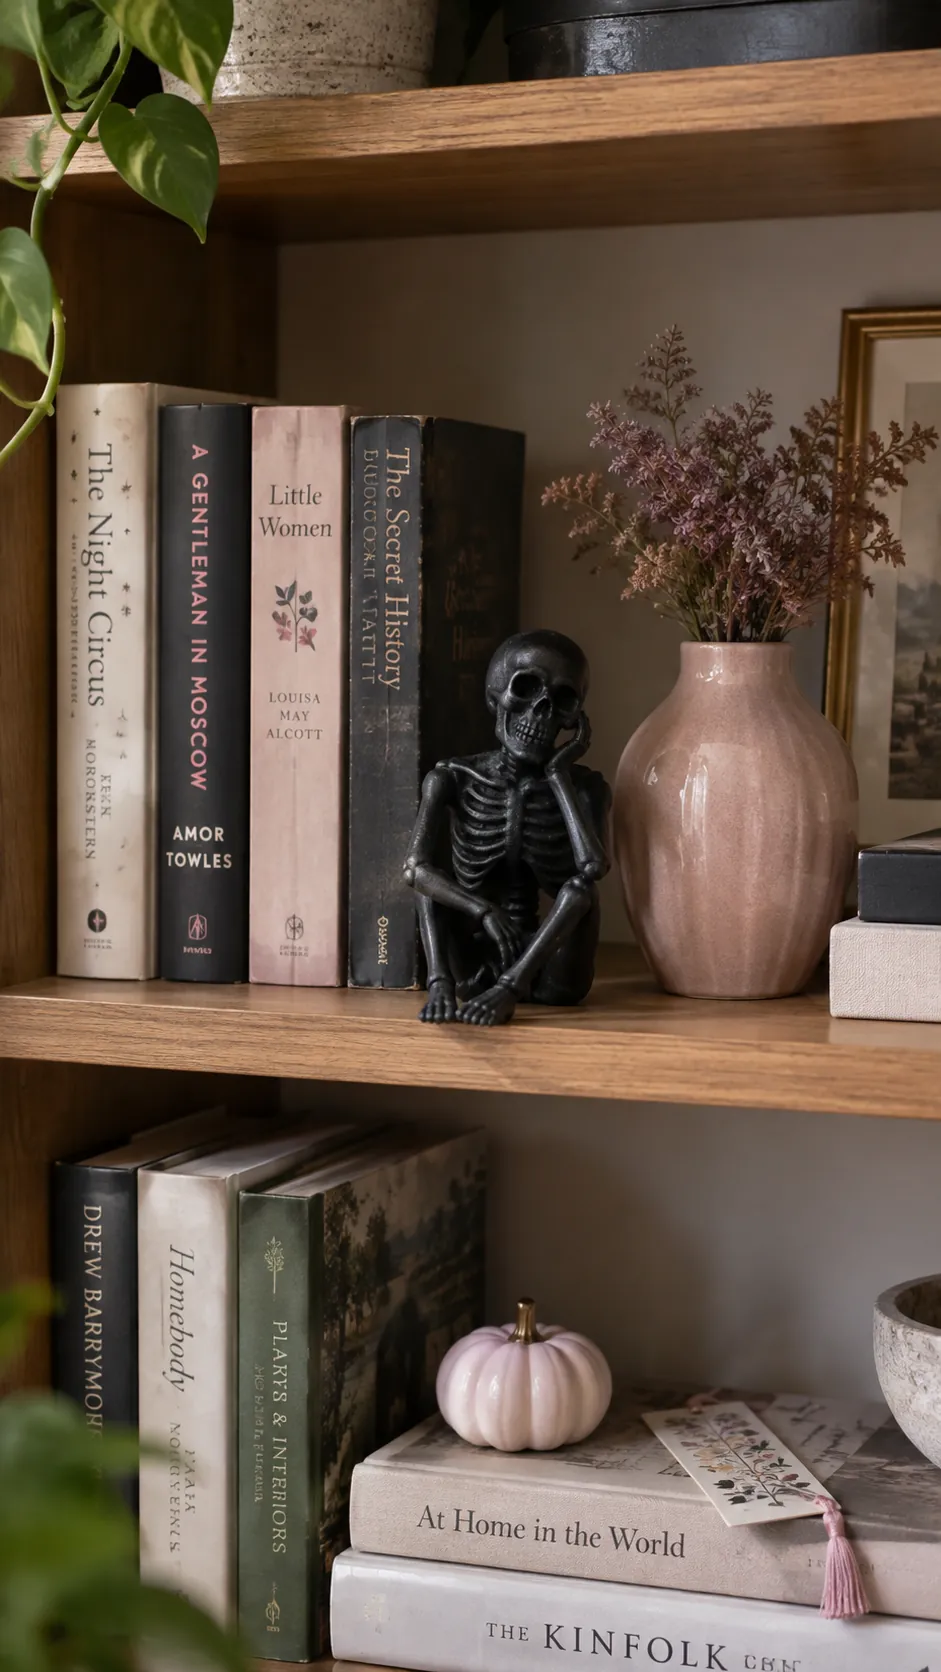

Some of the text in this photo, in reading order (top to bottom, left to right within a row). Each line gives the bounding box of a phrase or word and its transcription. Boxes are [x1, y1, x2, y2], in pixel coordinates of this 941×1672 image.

[269, 484, 322, 505] Little
[258, 516, 333, 538] Women
[80, 443, 113, 706] The Night Circus
[378, 447, 411, 690] The Secret History
[190, 444, 209, 791] A GENTLEMAN IN MOSCOW
[269, 691, 321, 704] LOUISA
[280, 710, 310, 721] MAY
[266, 728, 323, 740] ALCOTT
[173, 826, 225, 842] AMOR
[166, 852, 232, 869] TOWLES
[84, 1205, 102, 1279] DREW
[162, 1244, 195, 1392] Homebody
[272, 1412, 288, 1427] &
[272, 1436, 288, 1553] INTERIORS
[416, 1505, 686, 1558] At Home in the World
[486, 1622, 529, 1642] THE
[543, 1623, 729, 1671] KINFOLK
